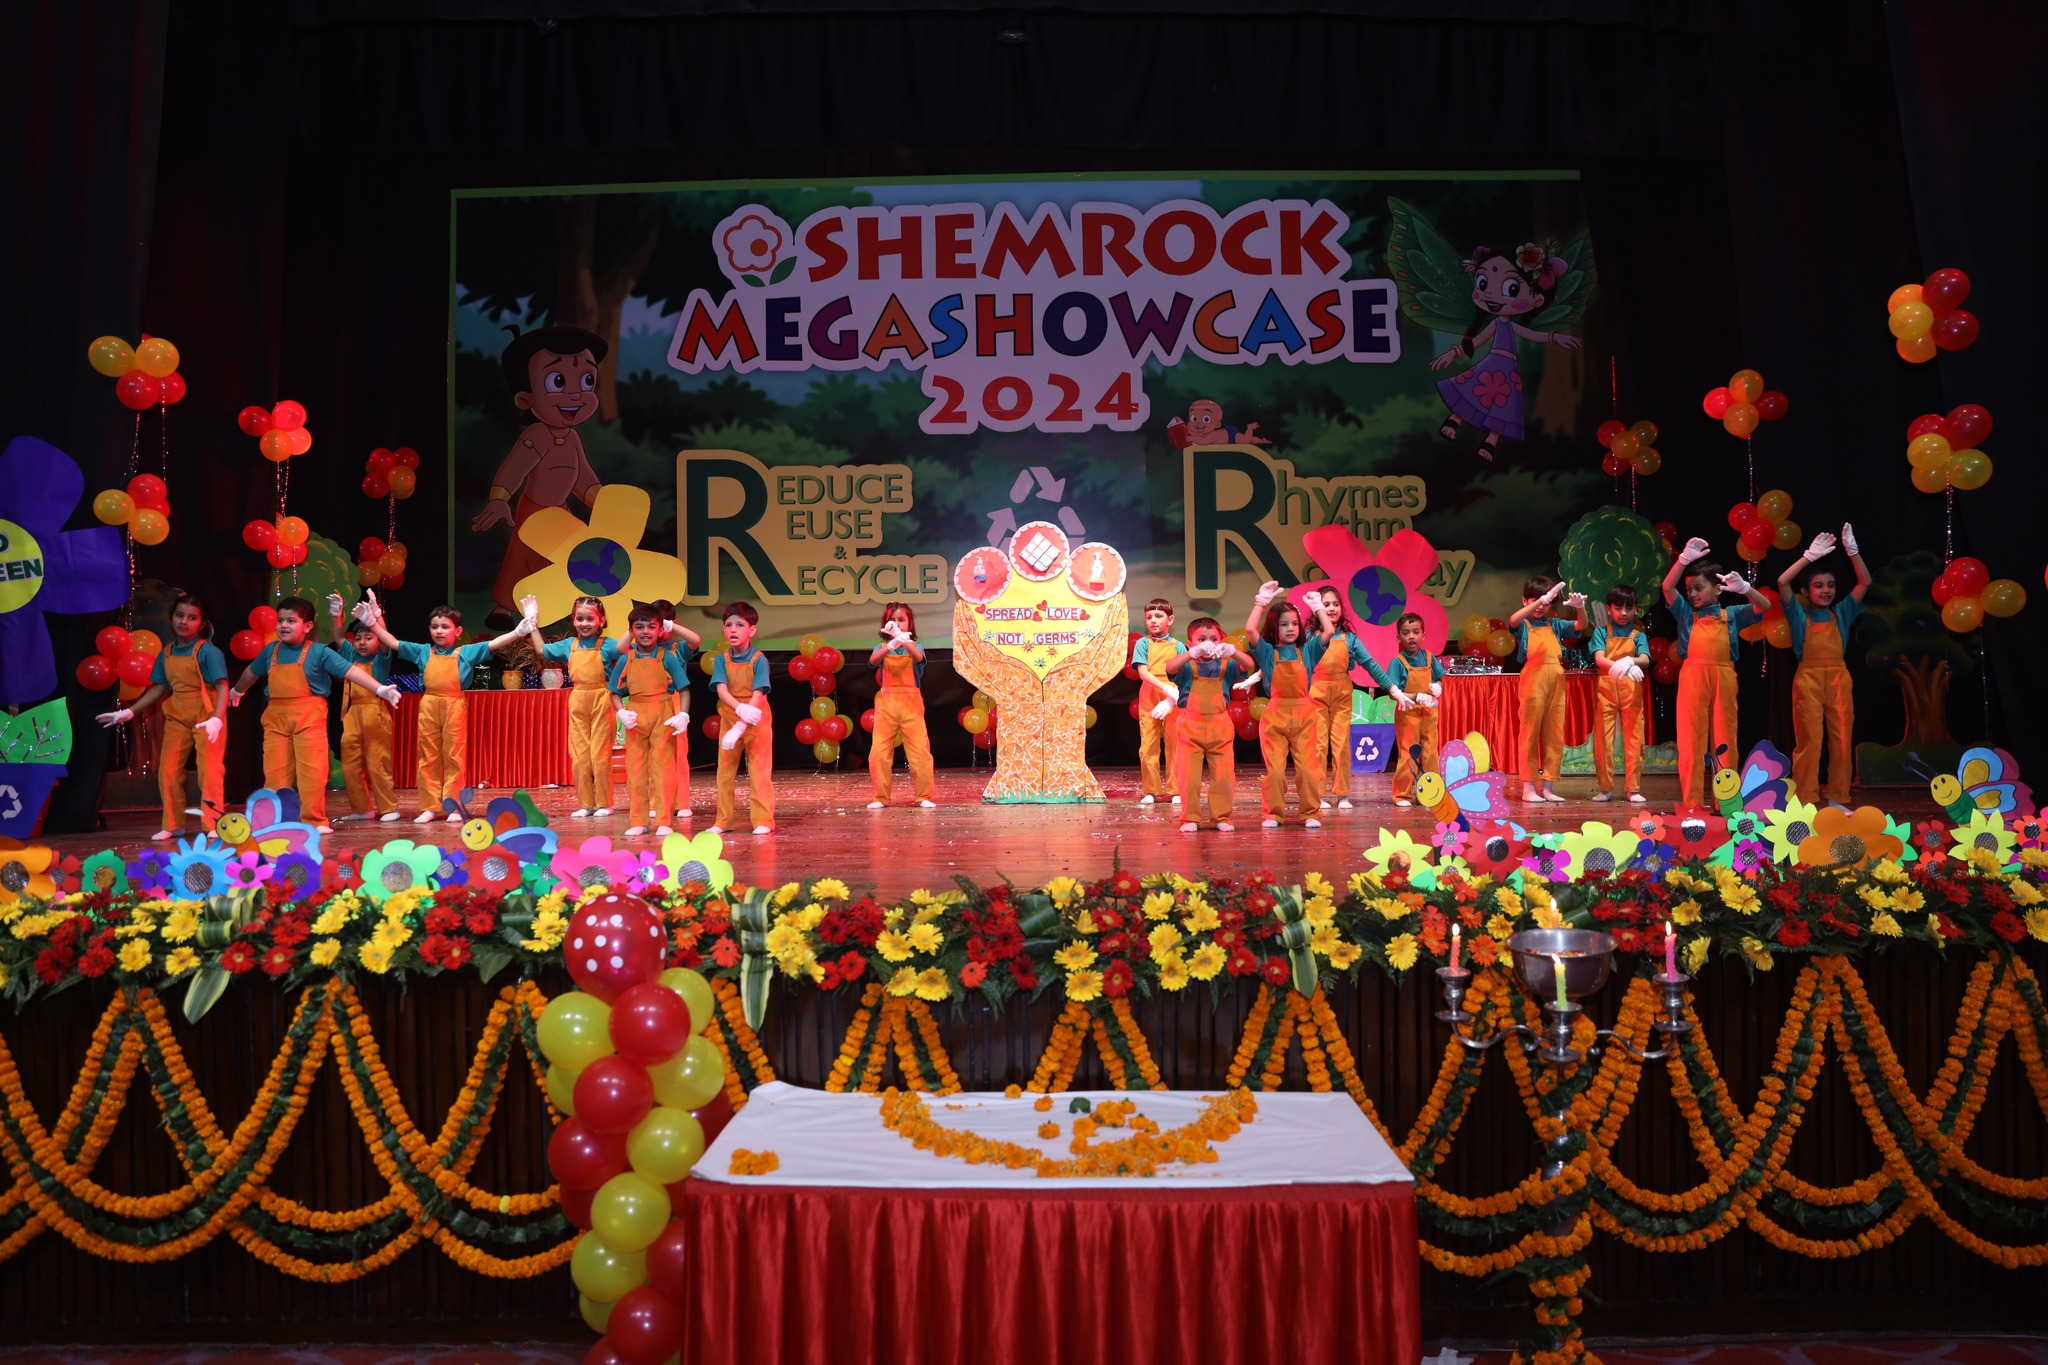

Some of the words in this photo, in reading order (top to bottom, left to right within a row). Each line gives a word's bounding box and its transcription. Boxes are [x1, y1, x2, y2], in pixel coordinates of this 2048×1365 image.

[806, 209, 1339, 283] SHEMROCK
[676, 288, 1392, 364] MEGASHOWCASE
[930, 373, 1140, 425] 2024
[833, 545, 847, 560] &
[985, 608, 1033, 620] SPREAD
[1047, 608, 1079, 619] LOVE
[997, 634, 1022, 645] NOT
[1036, 633, 1077, 645] GERMS
